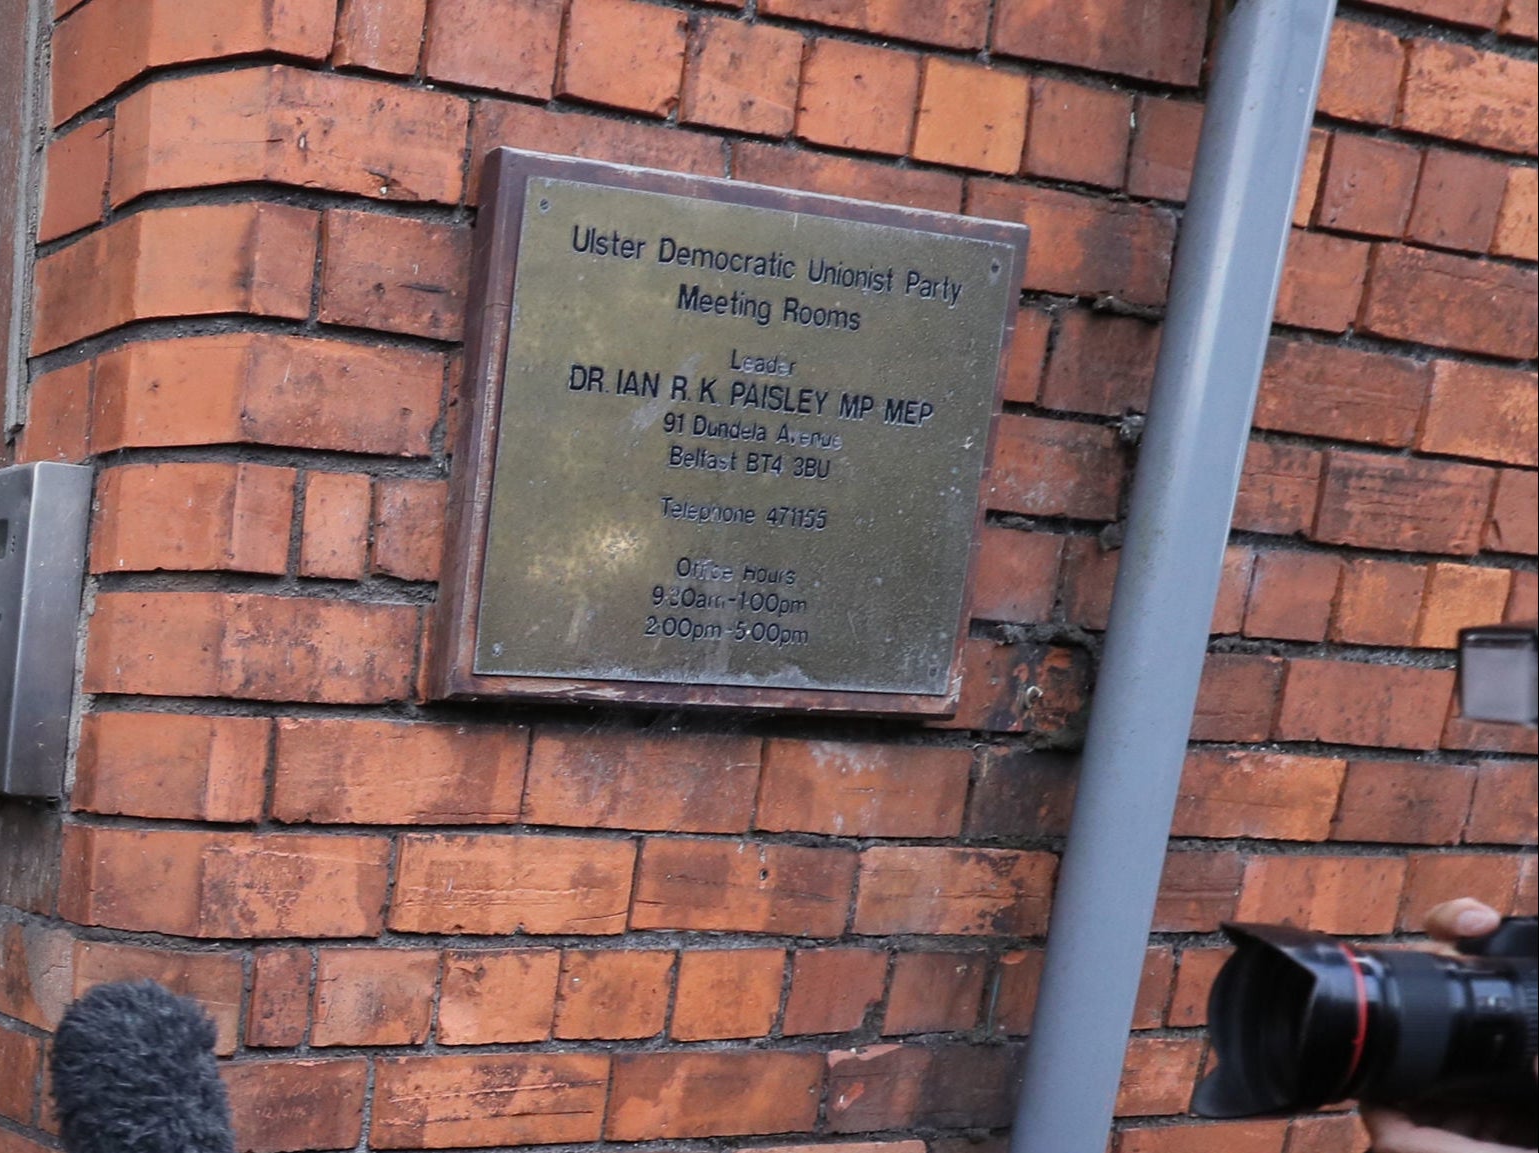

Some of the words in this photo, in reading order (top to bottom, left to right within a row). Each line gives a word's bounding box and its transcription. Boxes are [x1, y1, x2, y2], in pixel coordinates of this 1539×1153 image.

[572, 225, 646, 259] Ulster
[659, 237, 797, 279] Democratic
[808, 257, 893, 293] Unionist
[906, 270, 962, 308] Party
[677, 283, 771, 325] Meeting
[783, 296, 861, 331] Rooms
[730, 348, 796, 376] Leader
[569, 364, 609, 393] DR.
[616, 368, 660, 398] IAN
[730, 380, 828, 415] PAISLEY
[839, 392, 874, 421] MP
[884, 397, 934, 427] MEP
[663, 411, 685, 435] 91
[692, 413, 766, 443] Dundela
[775, 422, 844, 452] Avenue
[668, 445, 737, 472] Belfast
[745, 452, 783, 477] BT4
[793, 456, 832, 480] 3BU
[661, 496, 756, 525] Telephone
[766, 506, 829, 531] 471155
[676, 556, 734, 583] Office
[742, 564, 797, 587] Hours
